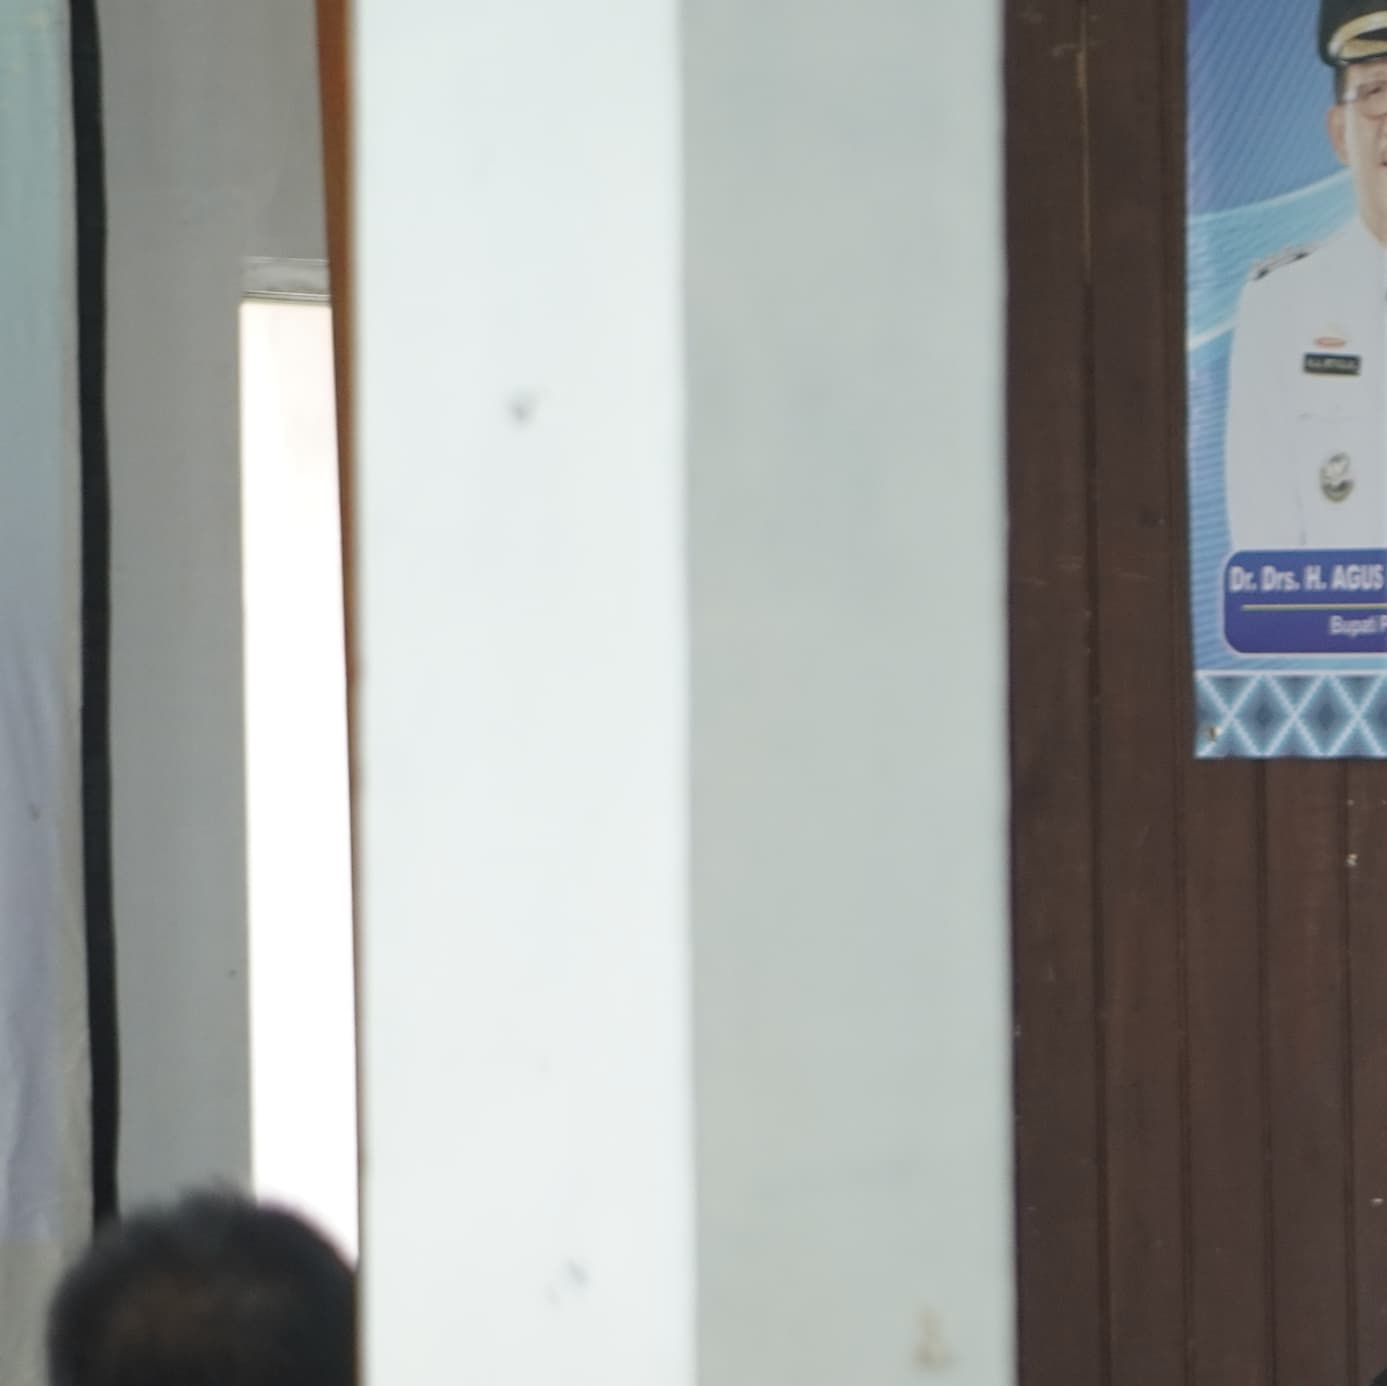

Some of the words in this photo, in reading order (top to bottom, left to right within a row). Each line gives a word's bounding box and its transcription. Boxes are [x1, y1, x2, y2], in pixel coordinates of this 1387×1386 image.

[1229, 566, 1257, 591] Dr.
[1261, 565, 1299, 591] Drs.
[1304, 564, 1327, 590] H.
[1331, 564, 1385, 590] AGUS
[1329, 614, 1377, 638] Bupati
